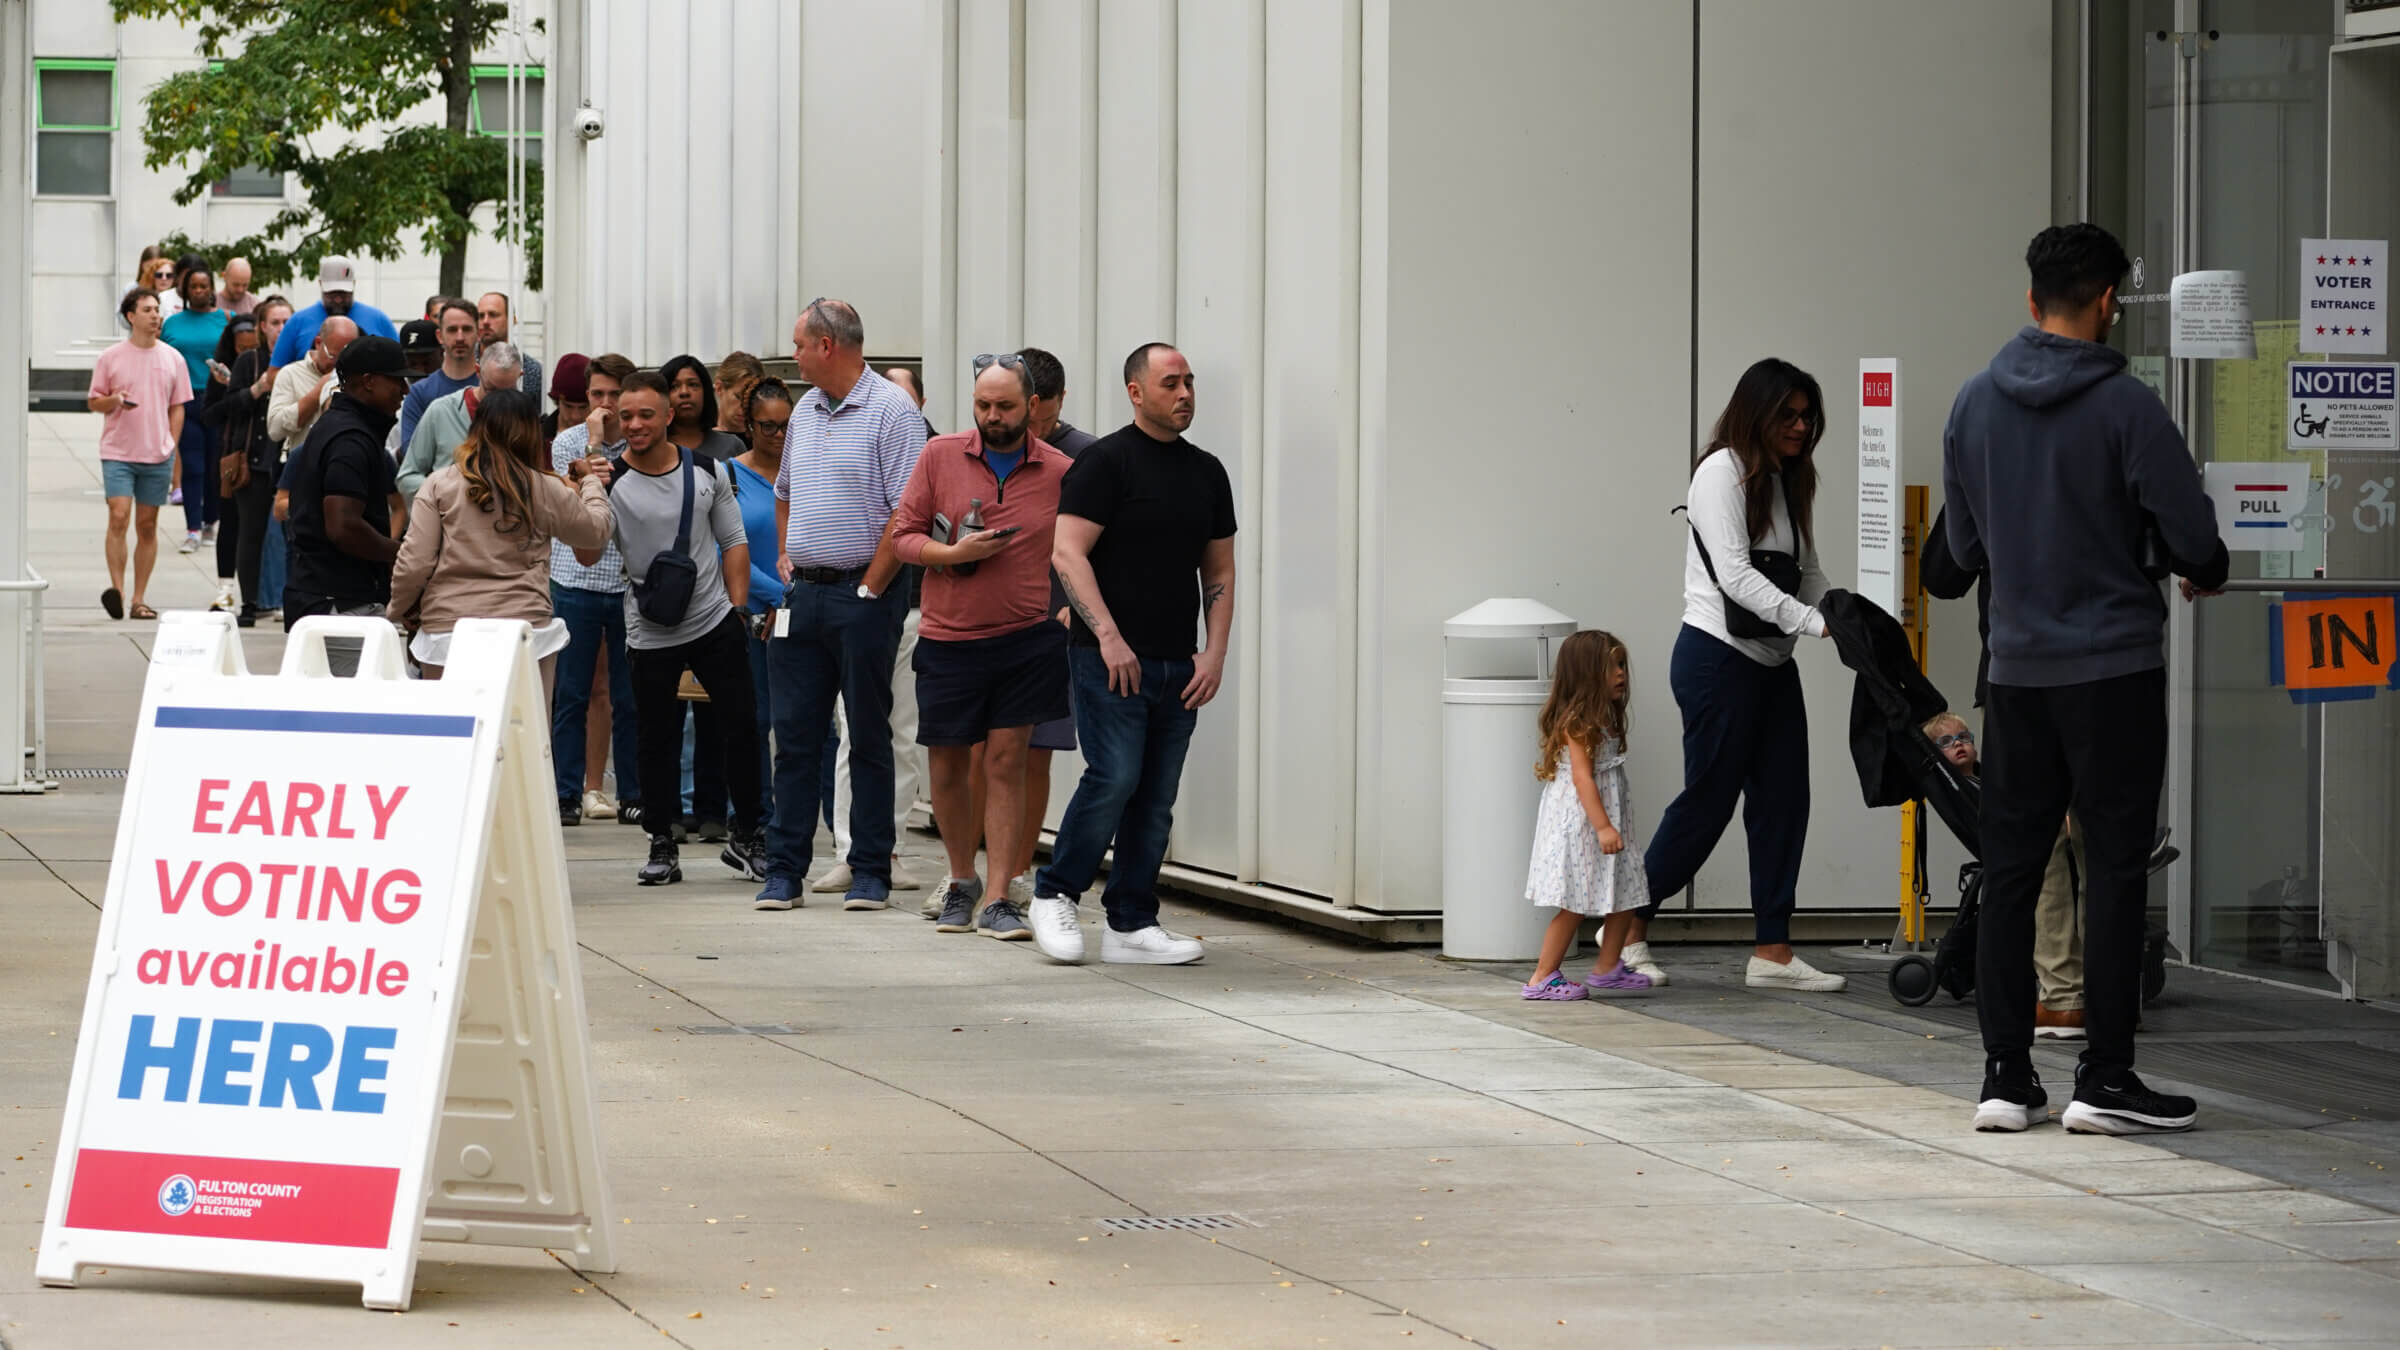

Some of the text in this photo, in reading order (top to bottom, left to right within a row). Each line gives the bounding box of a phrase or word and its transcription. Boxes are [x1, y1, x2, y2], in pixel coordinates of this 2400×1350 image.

[2315, 276, 2372, 289] VOTER
[2310, 299, 2376, 311] ENTRANCE
[1866, 382, 1889, 397] HIGH
[2295, 371, 2393, 394] NOTICE
[2339, 403, 2357, 411] PETS
[2359, 403, 2394, 411] ALLOWED
[2240, 500, 2281, 514] PULL
[2308, 609, 2381, 670] IN
[192, 779, 409, 841] EARLY
[155, 859, 422, 924] VOTING
[137, 939, 409, 997] available
[117, 1015, 398, 1115] HERE
[198, 1179, 302, 1199] FULTON COUNTY
[195, 1194, 263, 1208] REGISTRATION
[193, 1206, 252, 1218] & ELECTIONS
